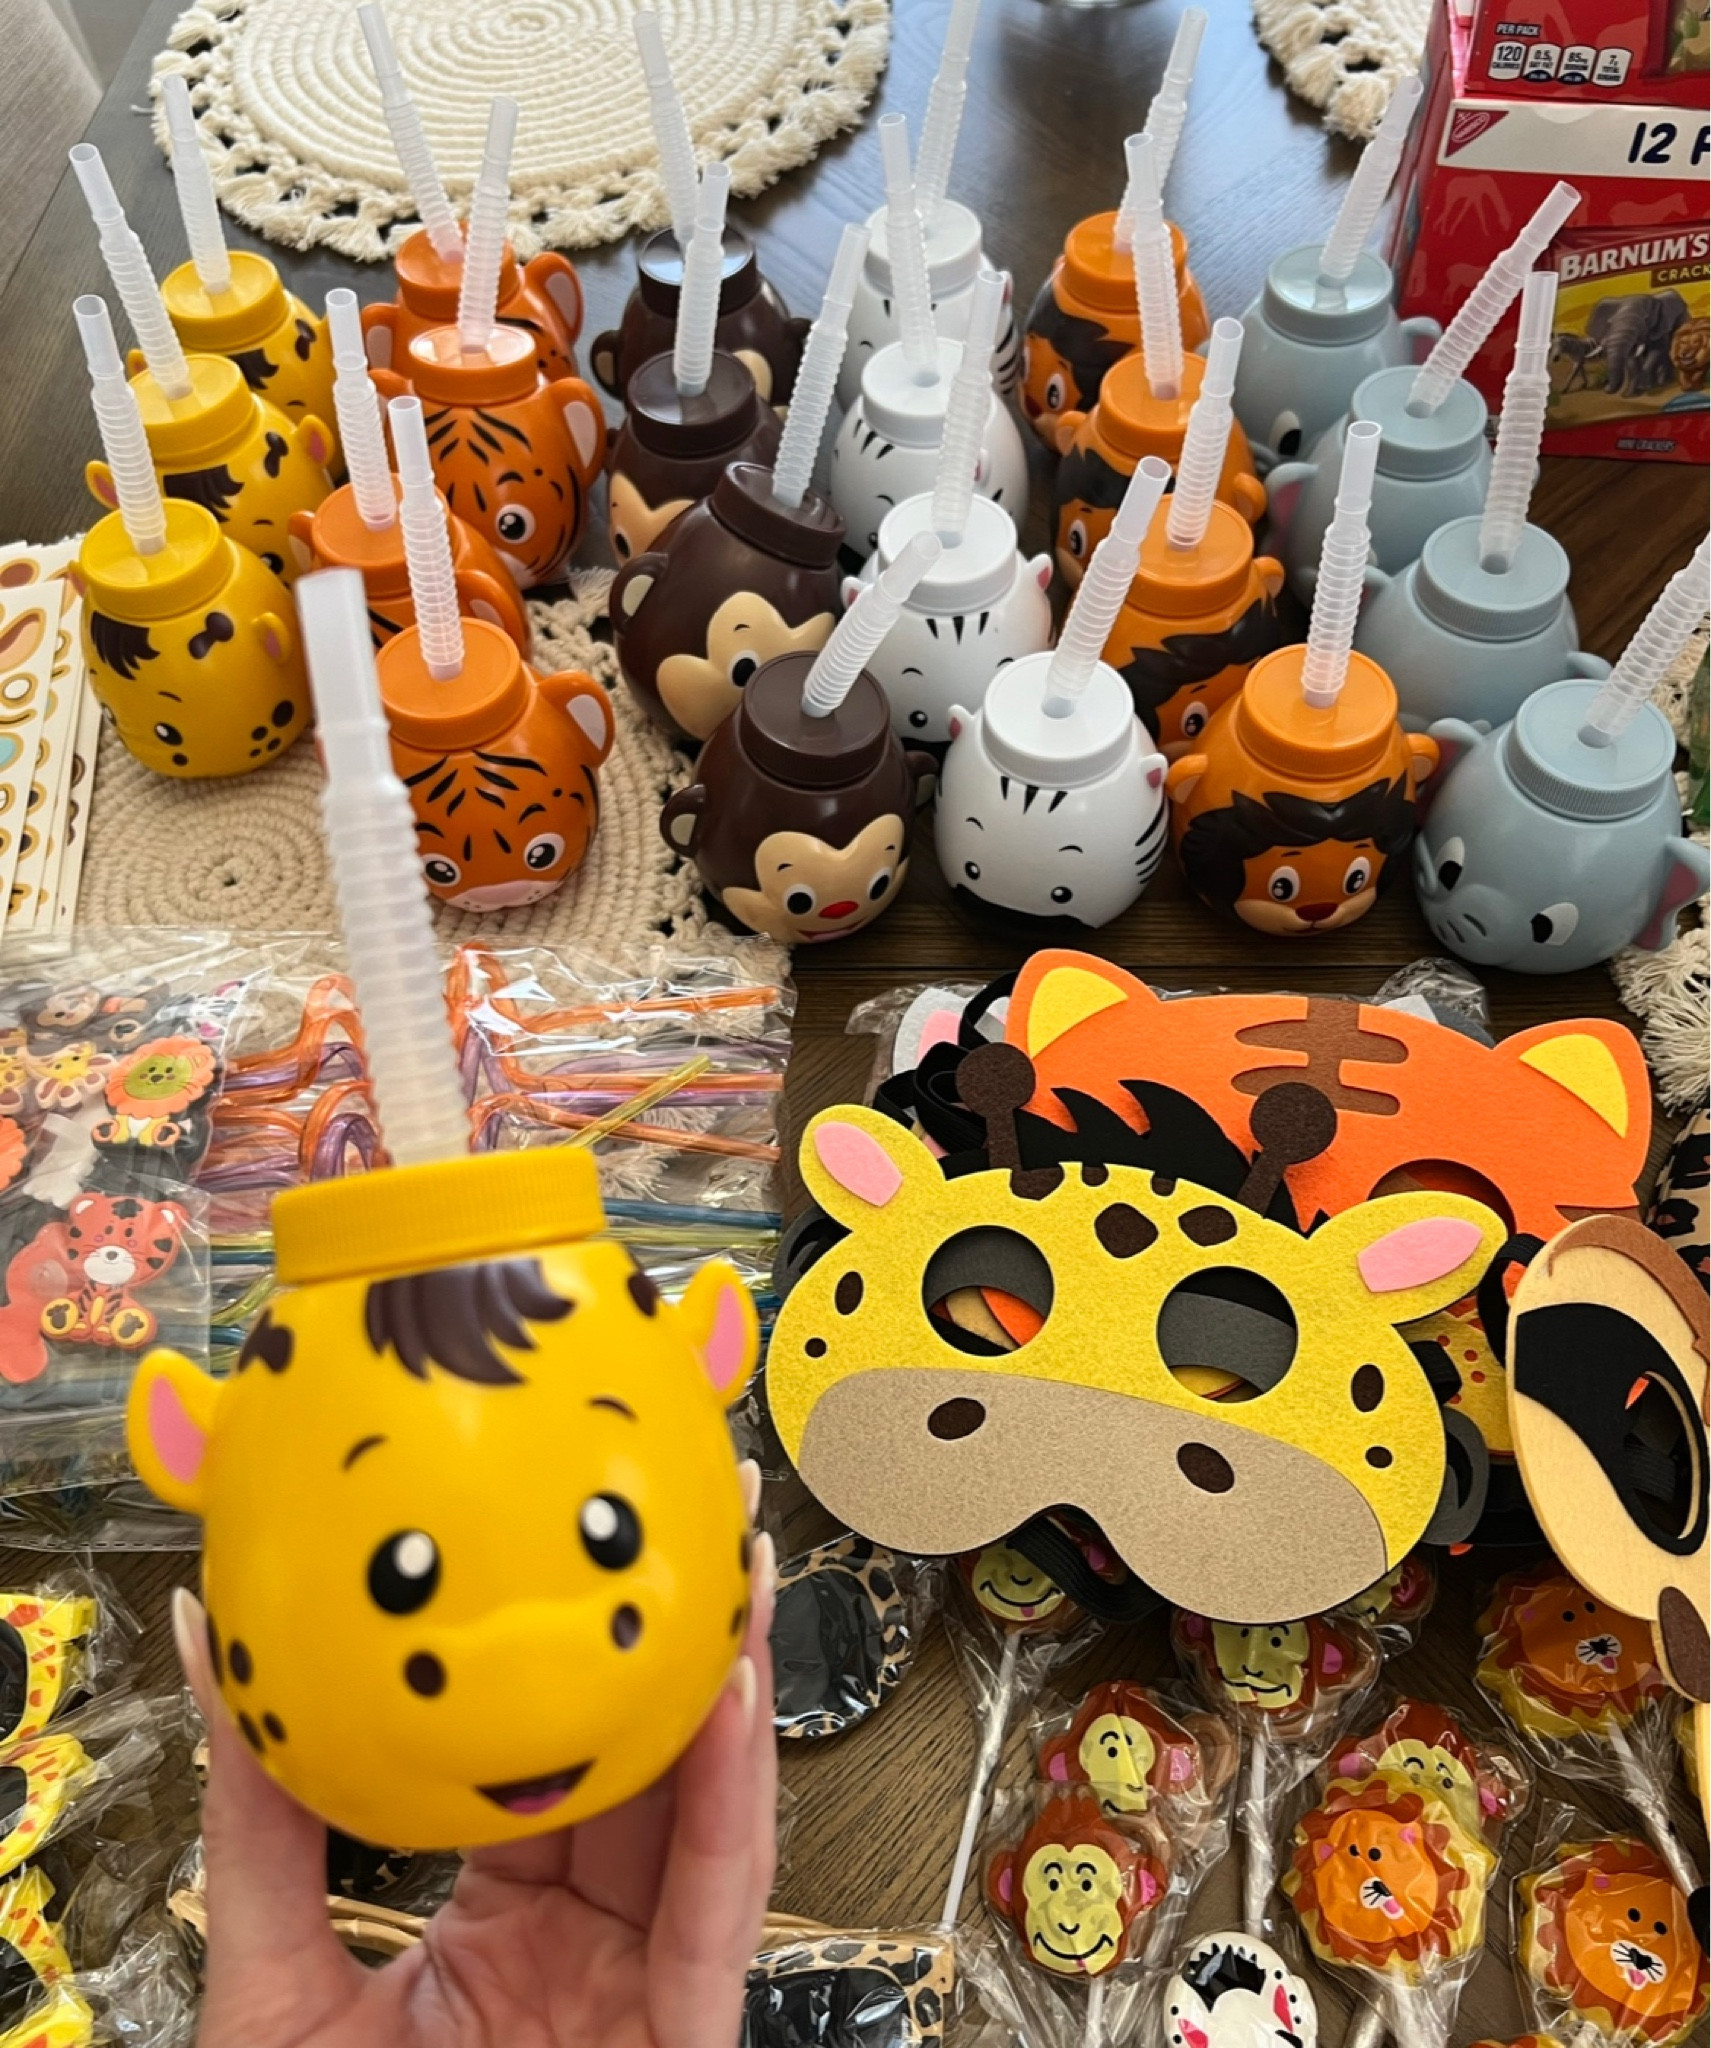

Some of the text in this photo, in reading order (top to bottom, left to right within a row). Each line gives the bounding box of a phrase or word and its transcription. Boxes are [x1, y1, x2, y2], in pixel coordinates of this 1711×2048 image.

[1497, 45, 1523, 61] 120
[1628, 122, 1677, 164] 12
[1560, 233, 1709, 282] BARNUM'S
